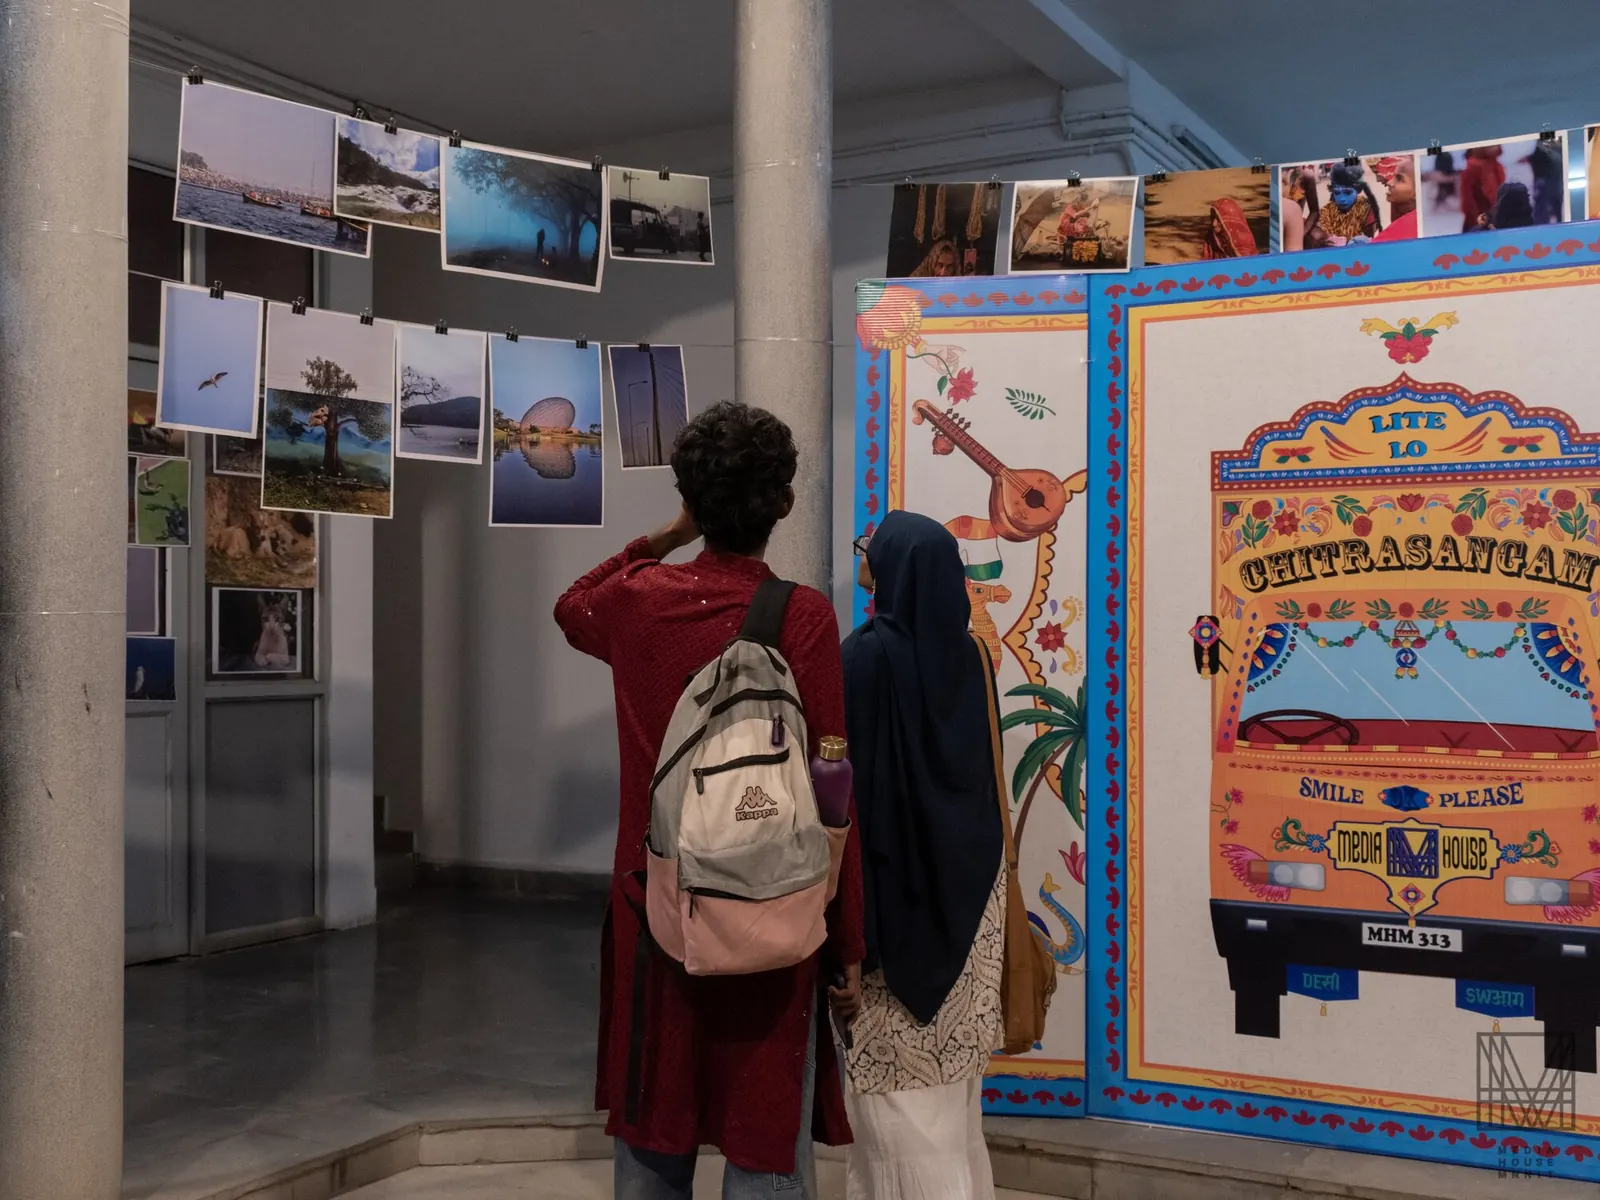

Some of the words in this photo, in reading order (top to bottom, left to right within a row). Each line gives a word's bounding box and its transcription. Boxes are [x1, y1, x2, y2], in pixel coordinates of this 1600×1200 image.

[1369, 411, 1447, 433] LITE
[1389, 440, 1427, 458] LO
[1239, 534, 1600, 593] CHITRASANGAM
[1299, 777, 1364, 804] SMILE
[1438, 782, 1524, 808] PLEASE
[736, 808, 778, 821] Kappa
[1367, 926, 1414, 944] MHM
[1417, 932, 1451, 949] 313
